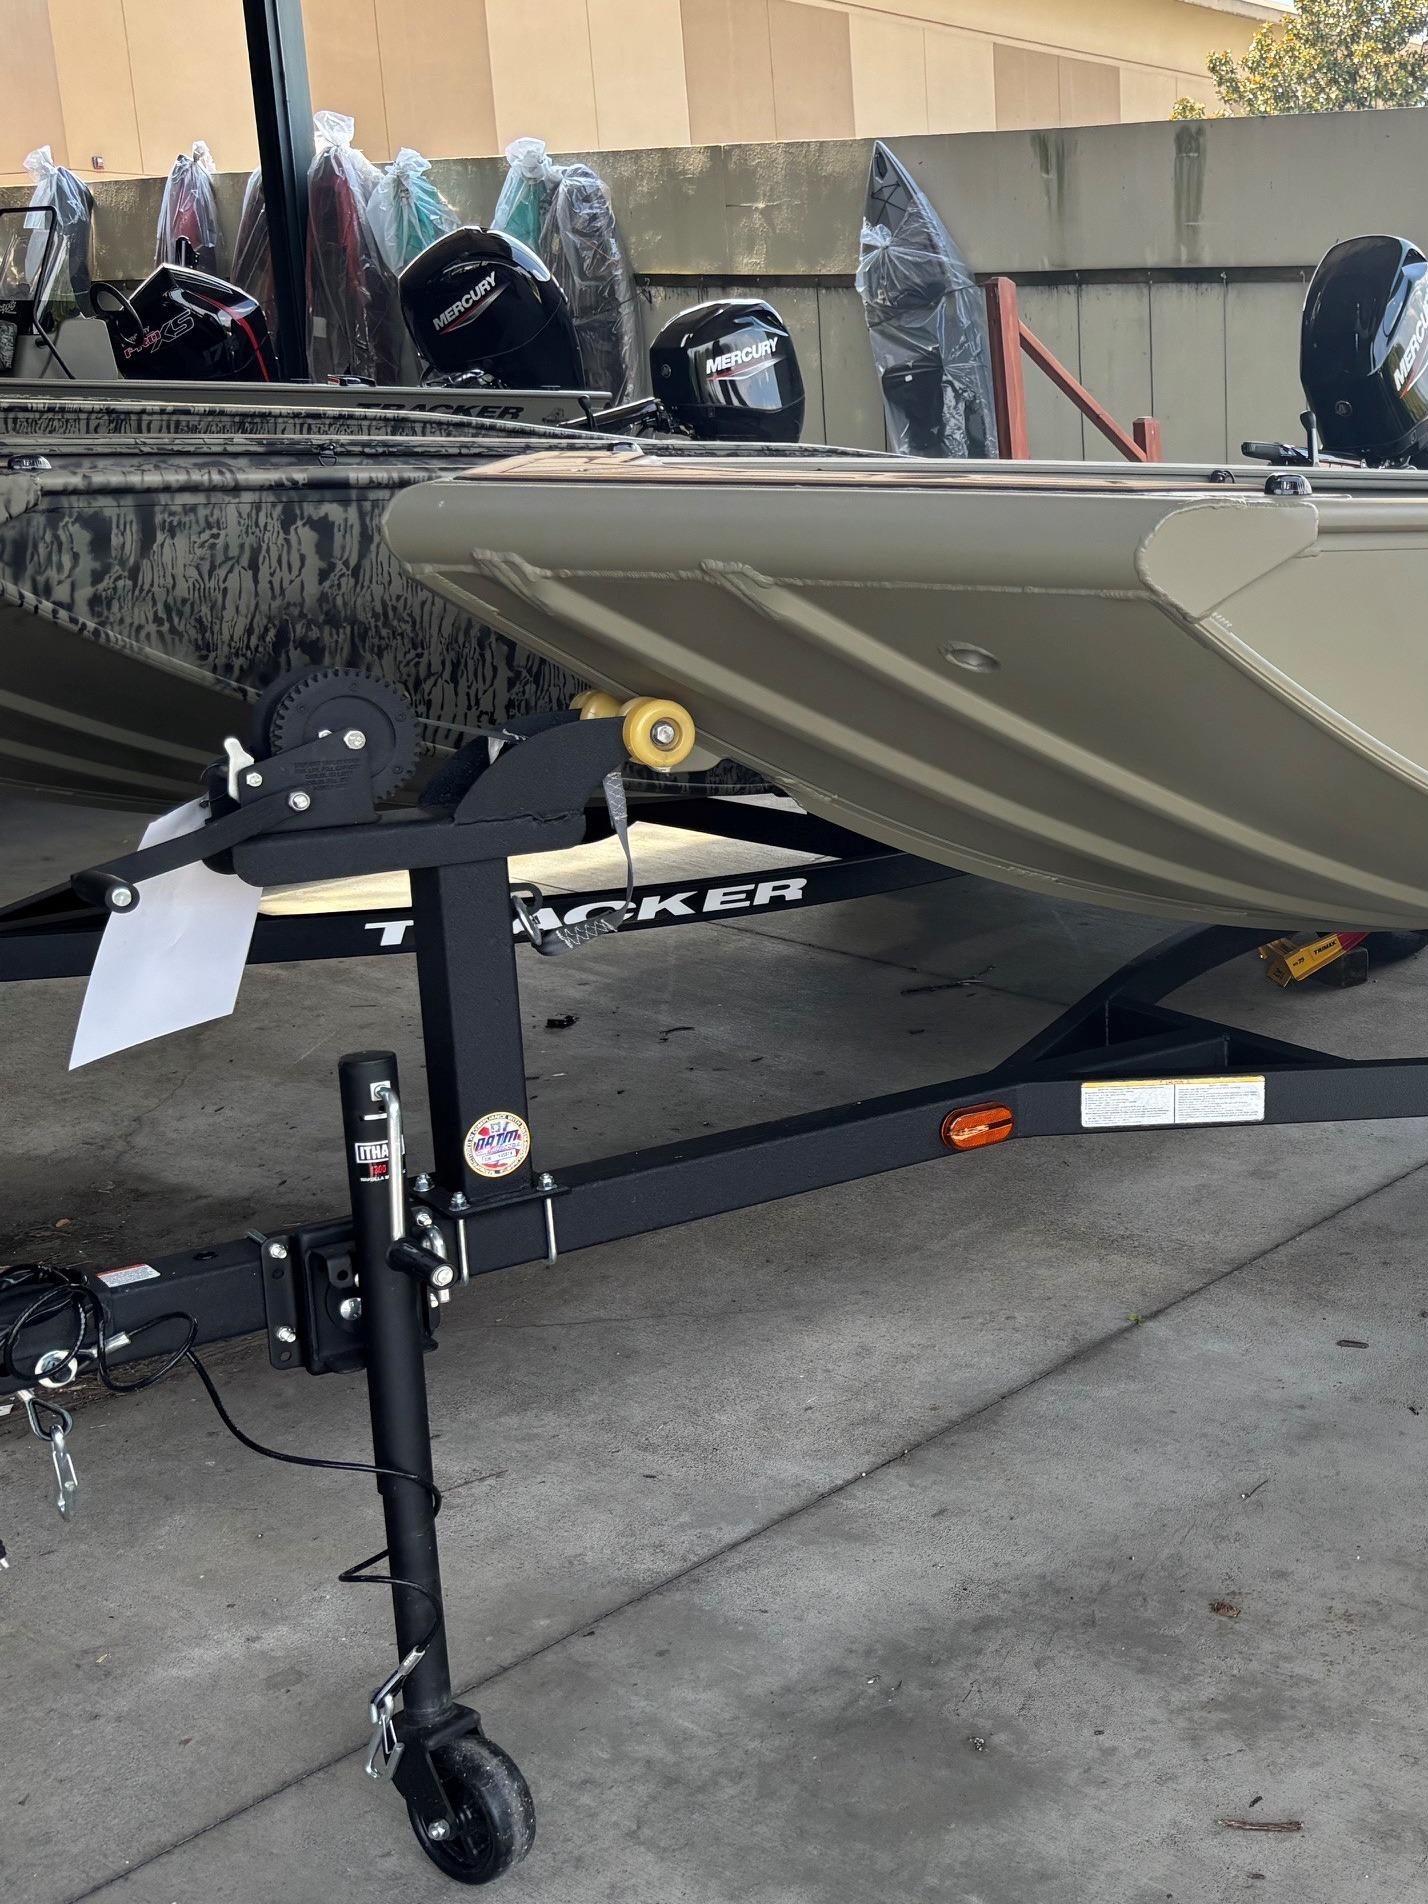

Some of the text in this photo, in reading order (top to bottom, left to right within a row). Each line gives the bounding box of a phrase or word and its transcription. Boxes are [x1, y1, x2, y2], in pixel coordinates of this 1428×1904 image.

[432, 271, 496, 331] MERCURY
[706, 336, 778, 374] MERCURY
[364, 878, 808, 947] TACKER
